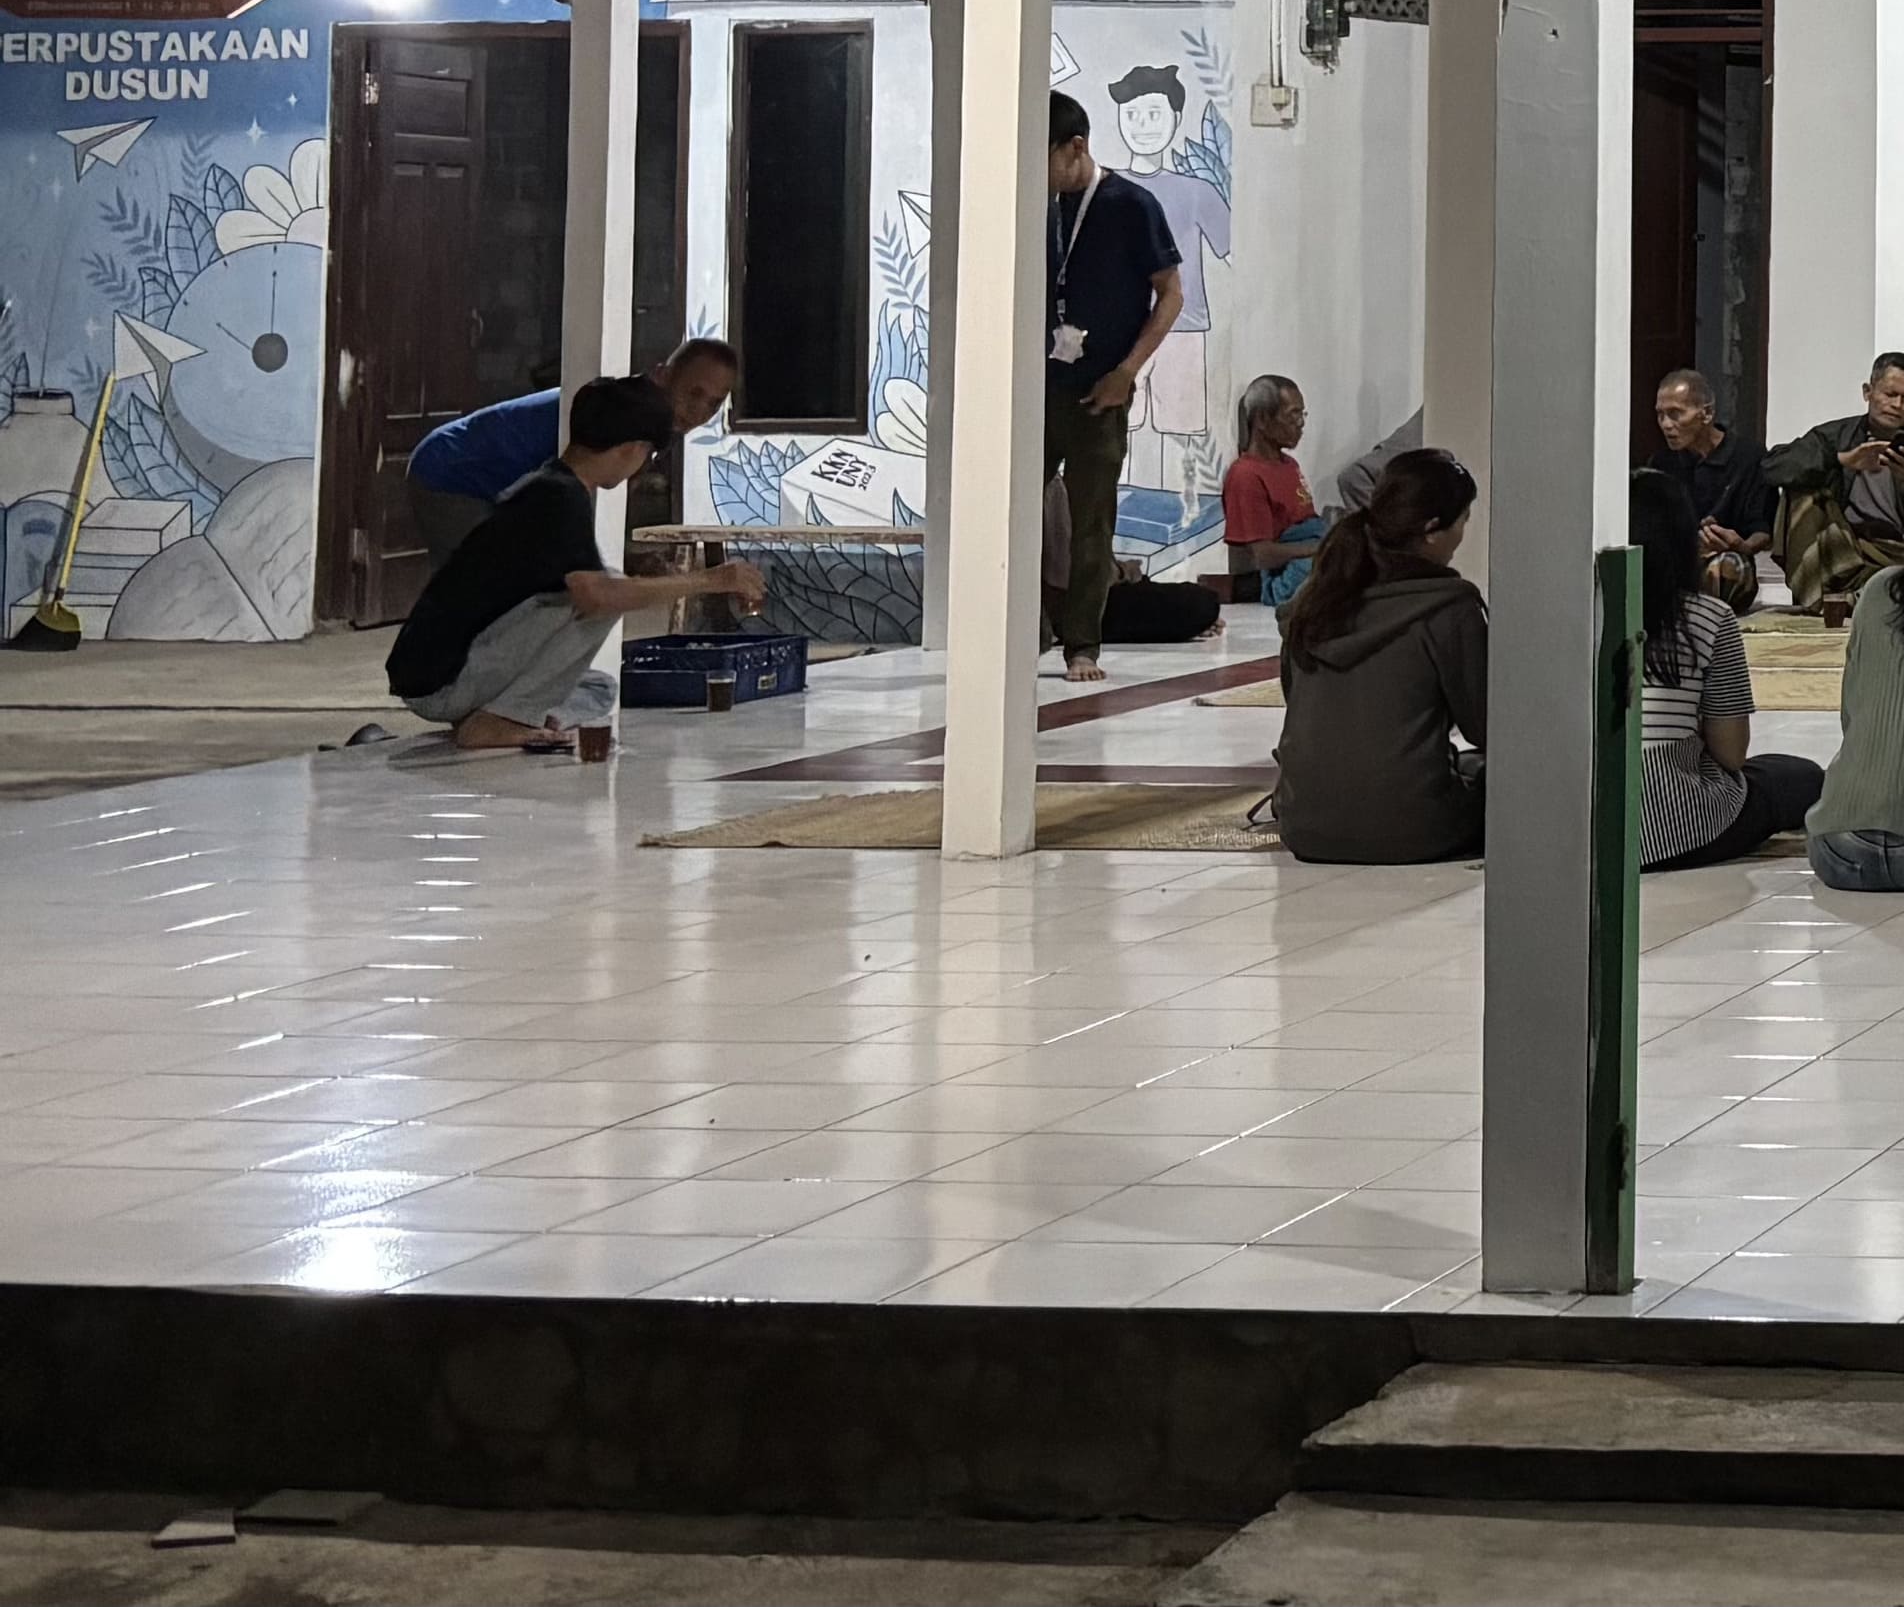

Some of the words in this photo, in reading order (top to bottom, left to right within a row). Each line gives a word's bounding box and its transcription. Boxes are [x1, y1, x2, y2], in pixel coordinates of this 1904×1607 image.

[0, 28, 309, 63] ERPUSTAKAAN
[65, 68, 209, 101] DUSUN
[810, 448, 855, 483] KKN
[836, 455, 868, 487] UNY
